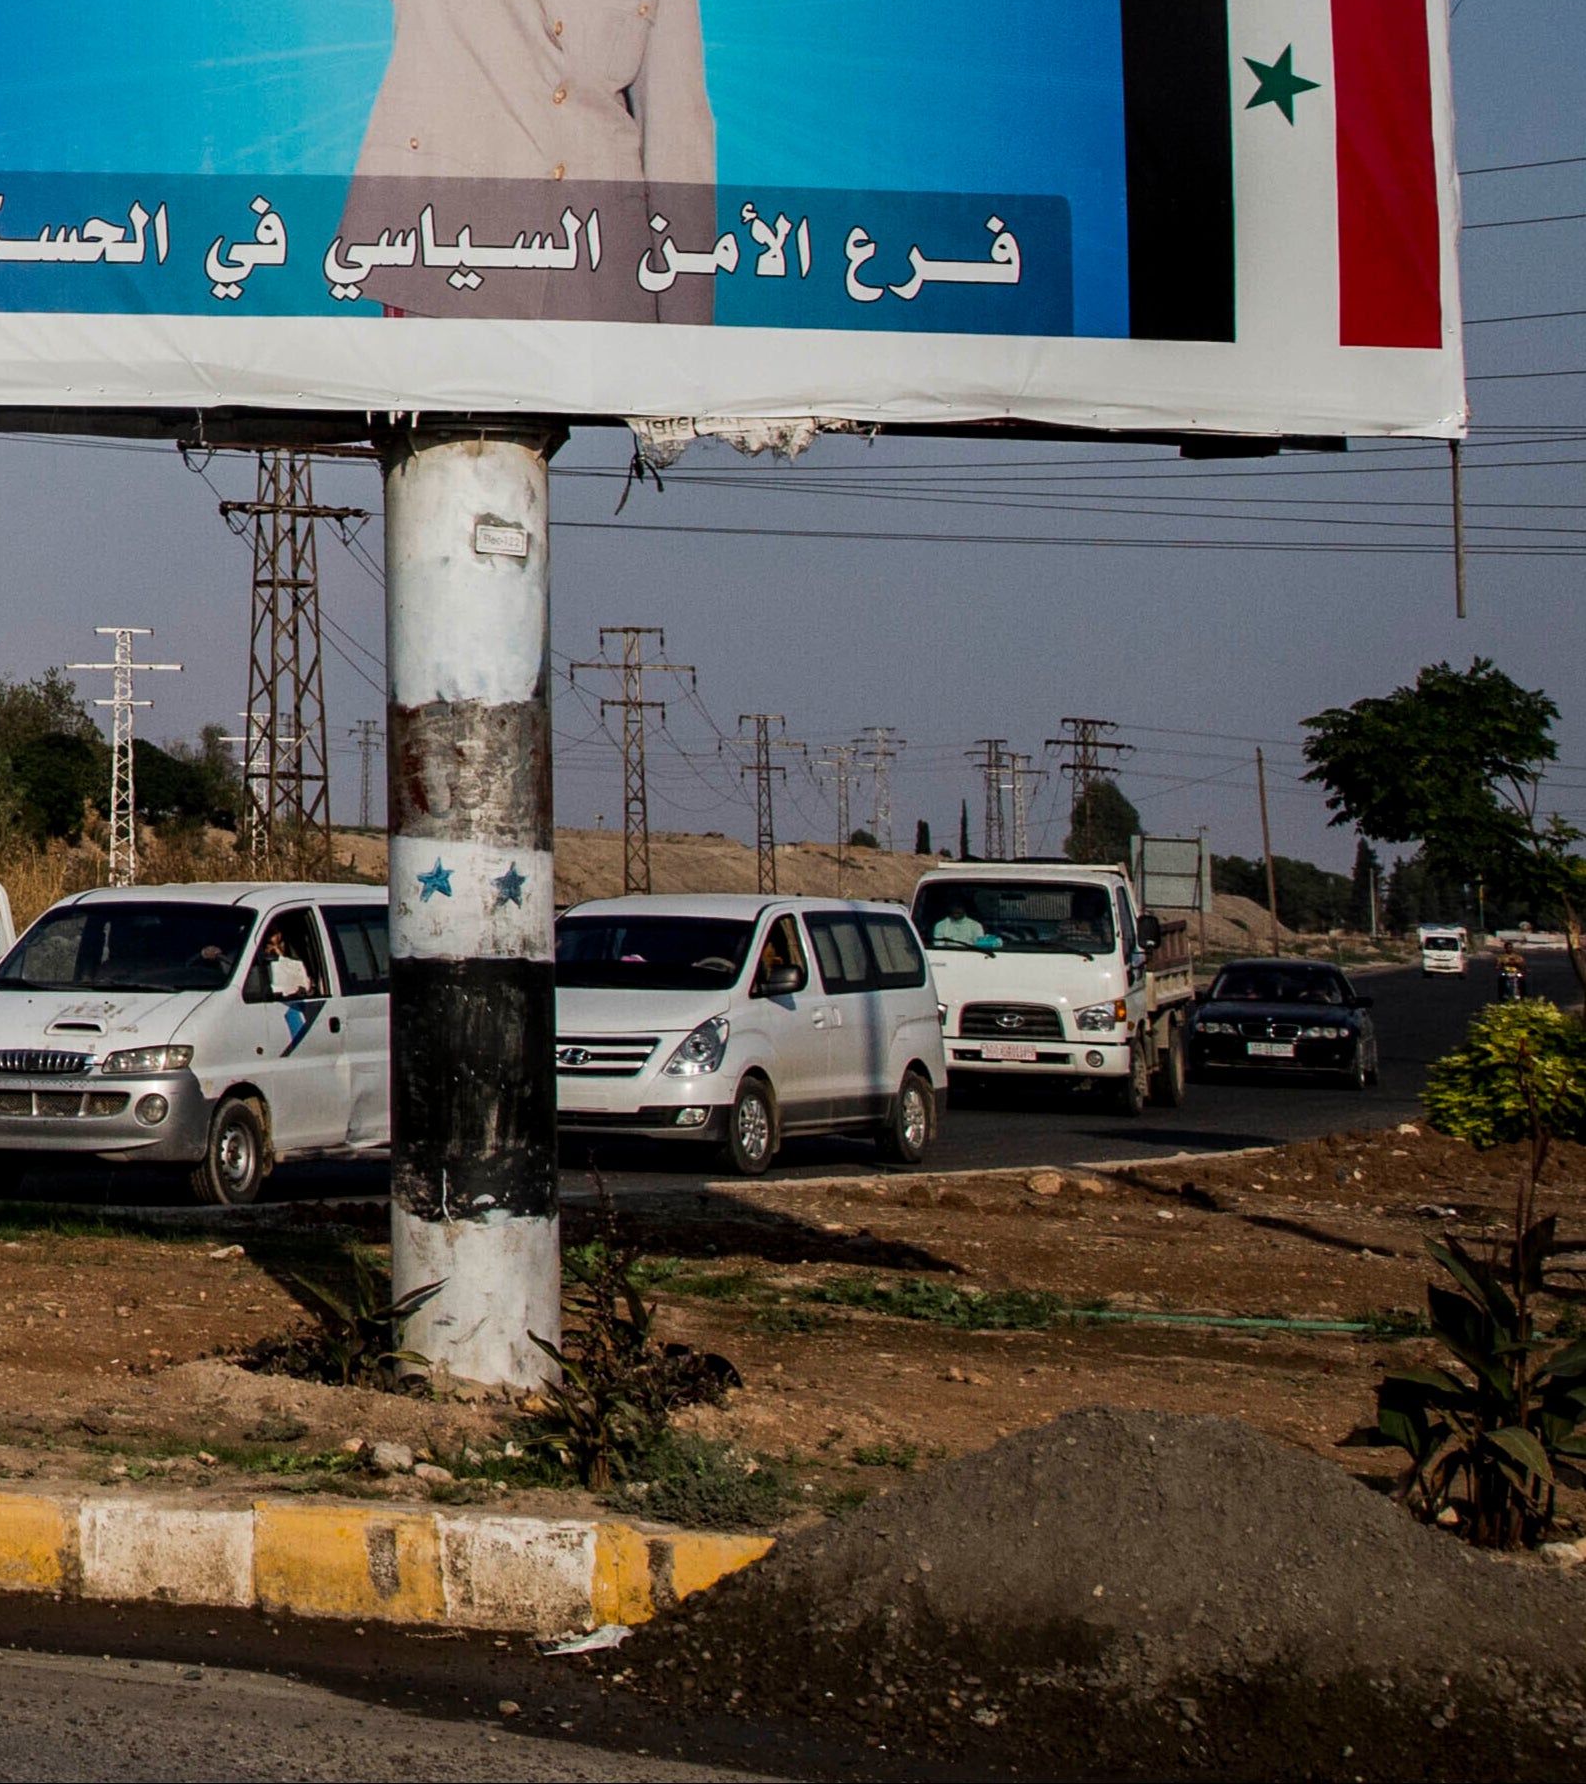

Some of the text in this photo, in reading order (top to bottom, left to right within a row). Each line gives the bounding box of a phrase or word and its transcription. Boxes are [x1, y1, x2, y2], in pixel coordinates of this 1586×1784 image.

[204, 194, 288, 301] في
[323, 204, 603, 302] السياسي
[636, 202, 813, 293] الأمن
[843, 214, 1022, 303] فرع
